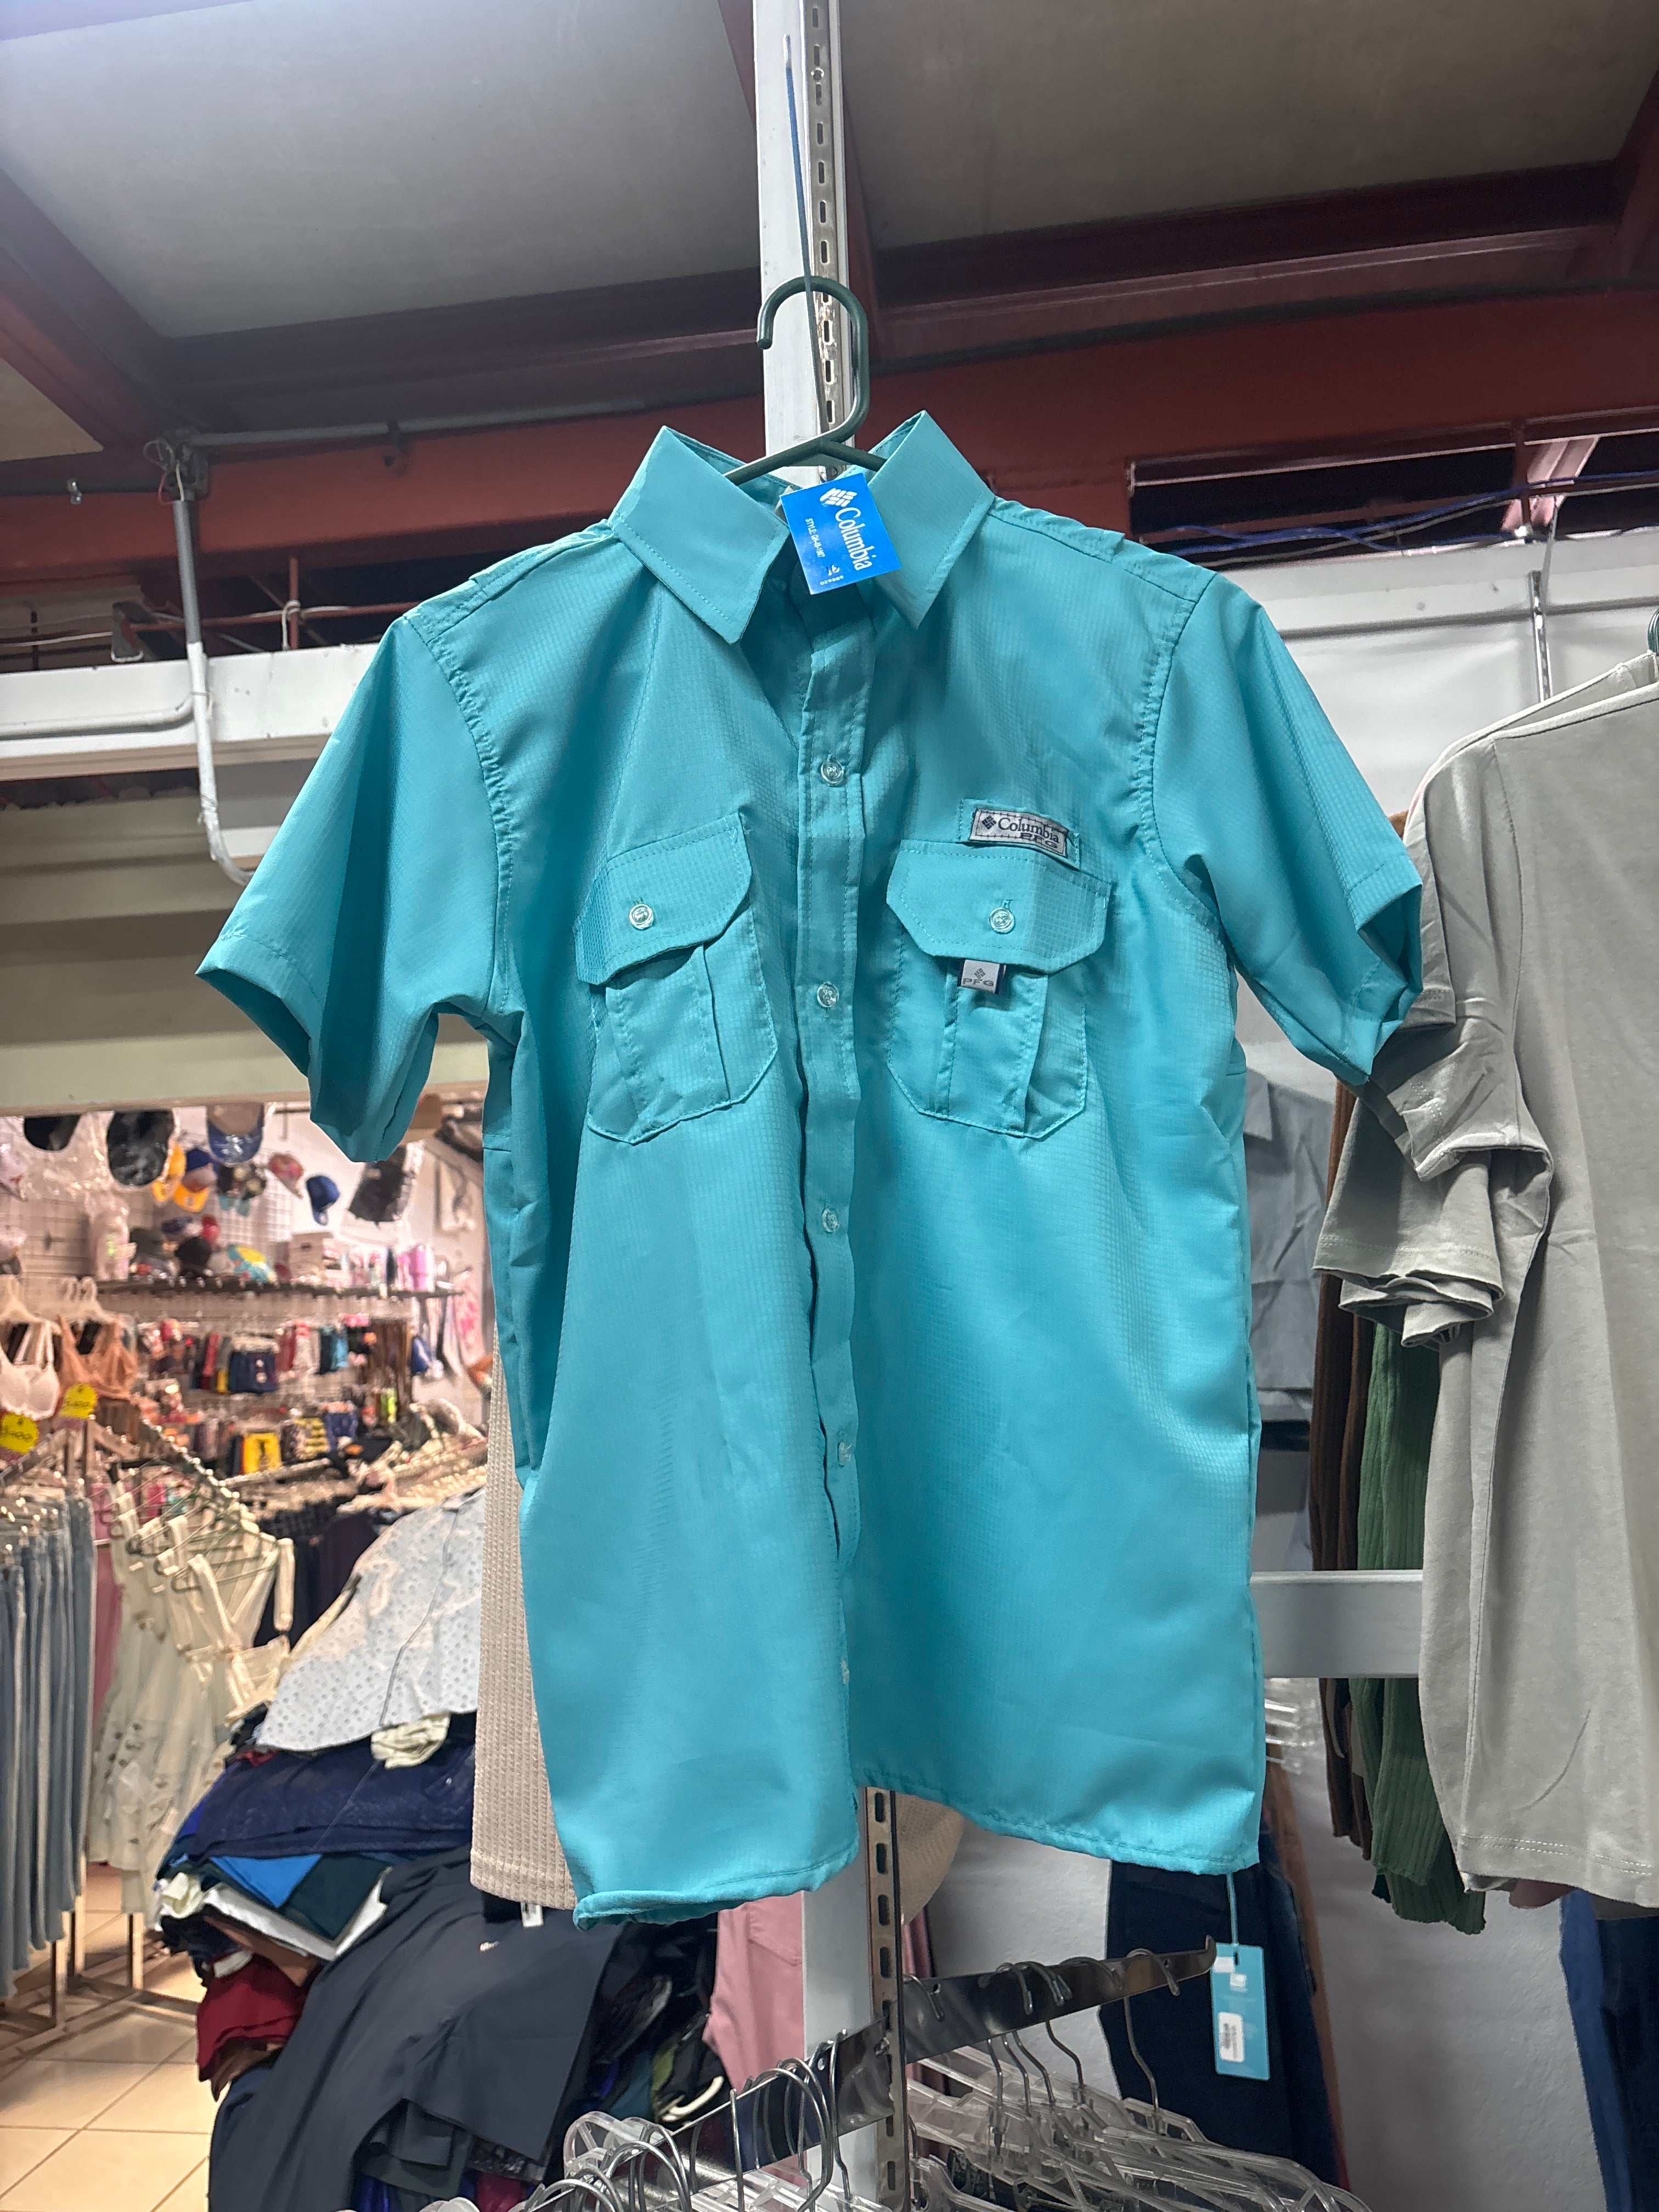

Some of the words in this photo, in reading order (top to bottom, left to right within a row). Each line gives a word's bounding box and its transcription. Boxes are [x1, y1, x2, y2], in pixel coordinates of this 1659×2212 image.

[835, 507, 877, 571] Columbia
[998, 817, 1059, 844] Columbia
[963, 978, 994, 987] PFG
